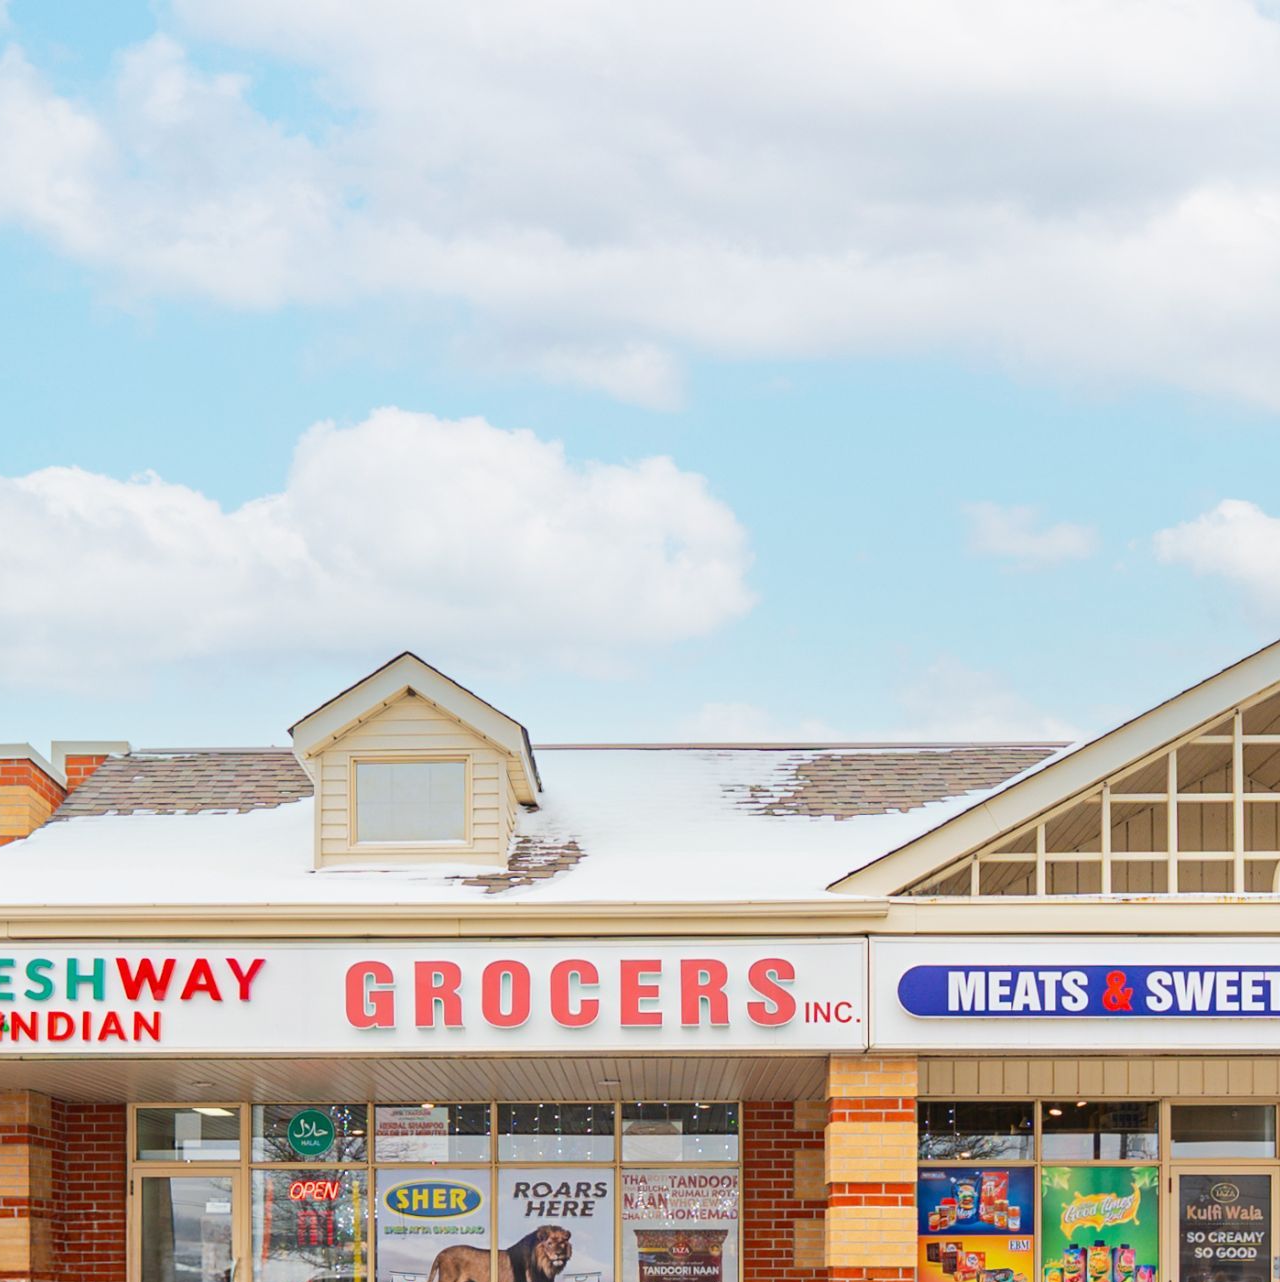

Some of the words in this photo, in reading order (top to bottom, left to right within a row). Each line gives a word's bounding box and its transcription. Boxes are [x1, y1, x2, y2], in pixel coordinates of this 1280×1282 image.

[345, 958, 797, 1029] GROCERS
[805, 1002, 862, 1024] INC.
[947, 971, 1089, 1012] MEATS
[1102, 970, 1133, 1012] &
[293, 1119, 329, 1138] حلال
[289, 1181, 339, 1200] OPEN
[513, 1181, 608, 1199] ROARS
[395, 1187, 468, 1211] SHER
[623, 1193, 668, 1209] NAAN
[524, 1200, 596, 1217] HERE
[1186, 1204, 1222, 1220] Kulfi
[1225, 1205, 1264, 1220] Wala
[1009, 1240, 1030, 1250] EBM
[1186, 1231, 1206, 1243] SO
[1208, 1231, 1265, 1243] CREAMY
[1194, 1247, 1213, 1259] SO
[1216, 1247, 1258, 1259] GOOD
[642, 1266, 691, 1275] TANDOORI
[693, 1266, 719, 1275] NAAN
